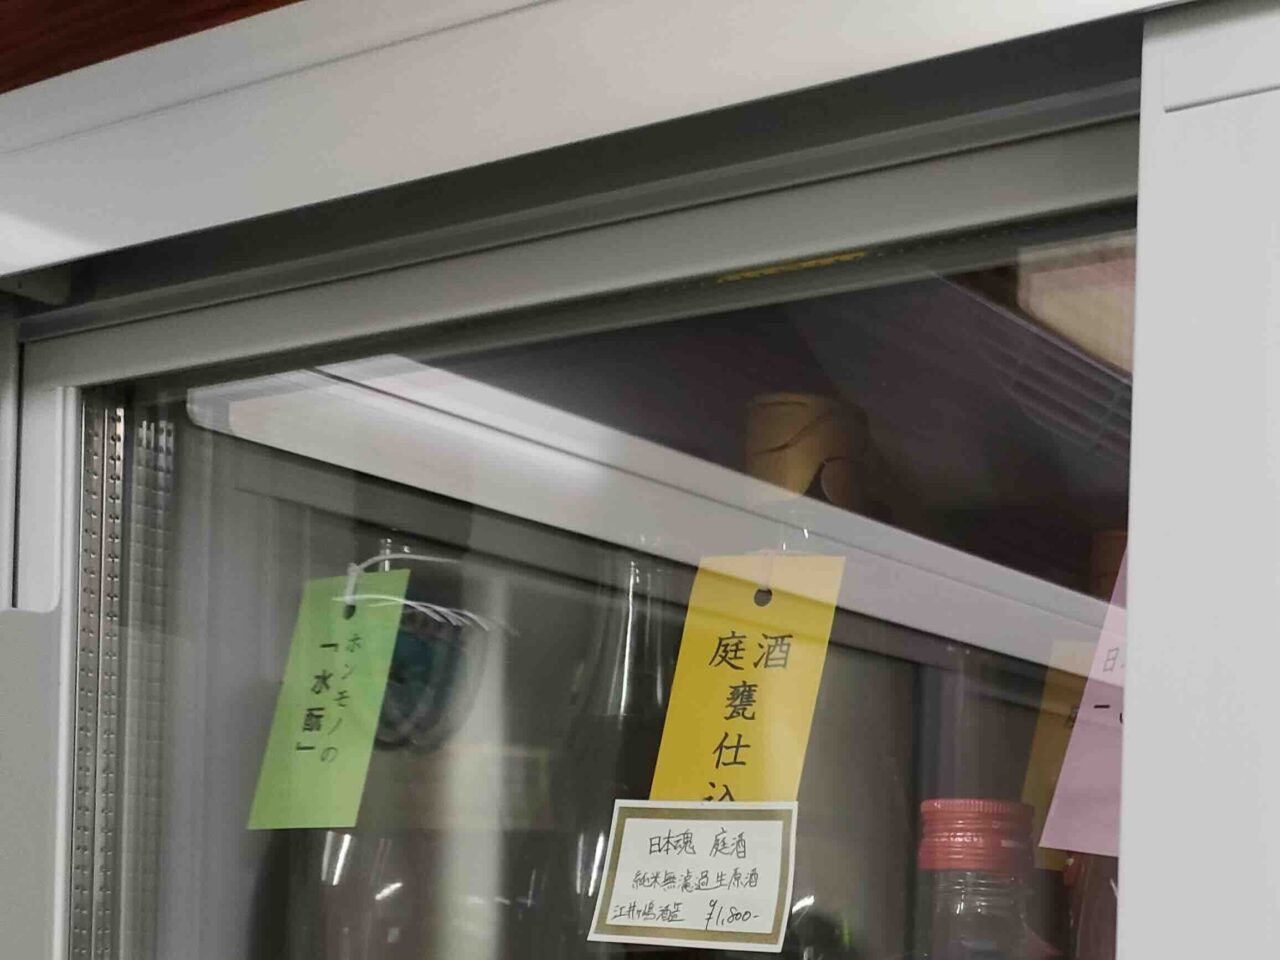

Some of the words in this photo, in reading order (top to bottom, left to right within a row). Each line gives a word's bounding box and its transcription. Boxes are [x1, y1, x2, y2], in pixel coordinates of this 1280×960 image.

[649, 828, 697, 857] 日本魂
[709, 827, 748, 859] 庭酒
[632, 867, 759, 893] 純米無濾過生原酒
